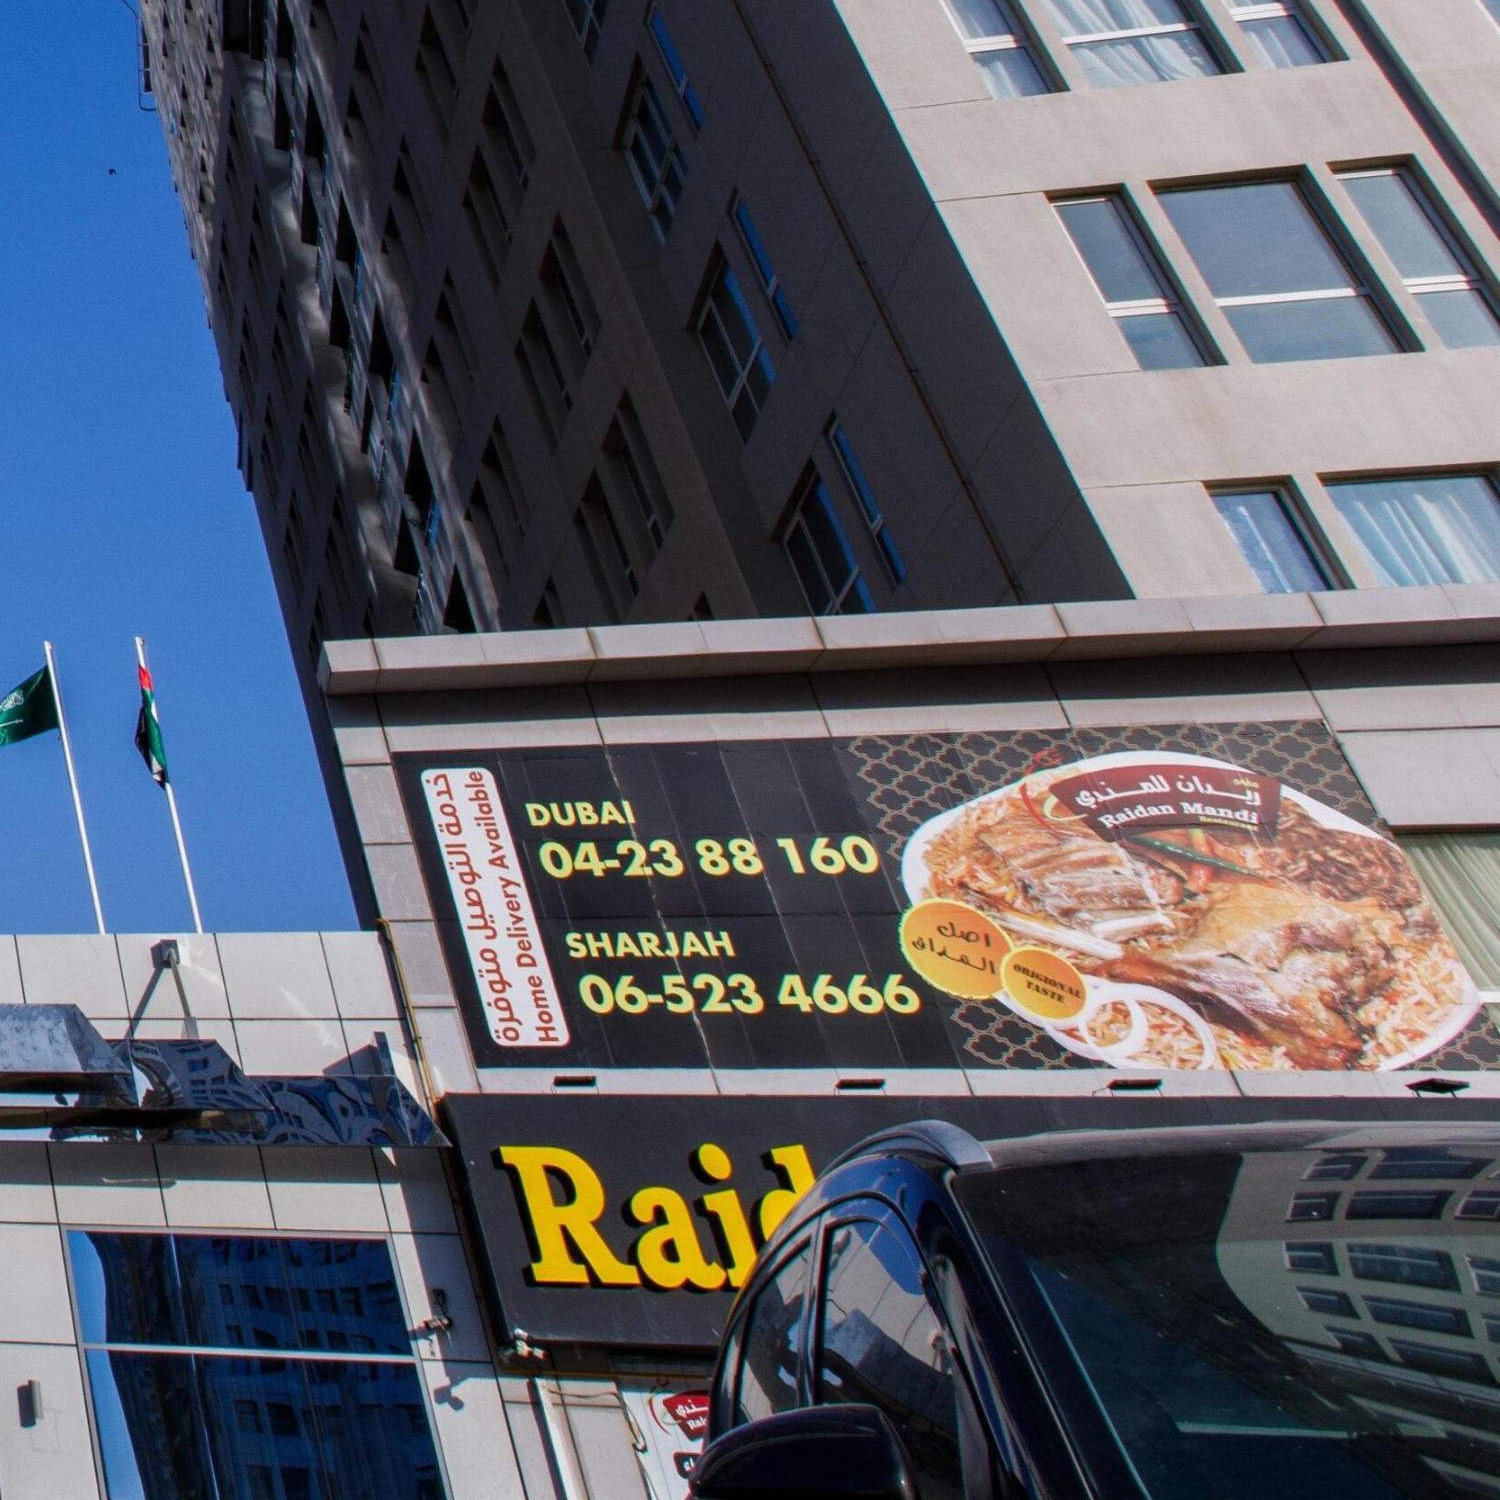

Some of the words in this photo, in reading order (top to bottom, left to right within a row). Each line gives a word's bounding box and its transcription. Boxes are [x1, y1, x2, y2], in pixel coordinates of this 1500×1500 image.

[465, 771, 510, 870] Available
[525, 801, 636, 827] DUBAI
[1097, 804, 1176, 829] Raidan
[1180, 801, 1259, 825] Mandi
[539, 839, 685, 879] 04-23
[696, 837, 764, 875] 88
[777, 835, 879, 874] 160
[426, 773, 462, 836] خدمة
[445, 843, 497, 940] التوصيل
[478, 948, 523, 1042] متوفرة
[499, 876, 538, 968] Delivery
[565, 931, 736, 959] SHARJAH
[578, 974, 766, 1015] 06-523
[777, 974, 921, 1015] 4666
[1012, 963, 1082, 998] ORIGIONAL
[1026, 981, 1066, 1004] TASTE
[528, 975, 560, 1042] Home
